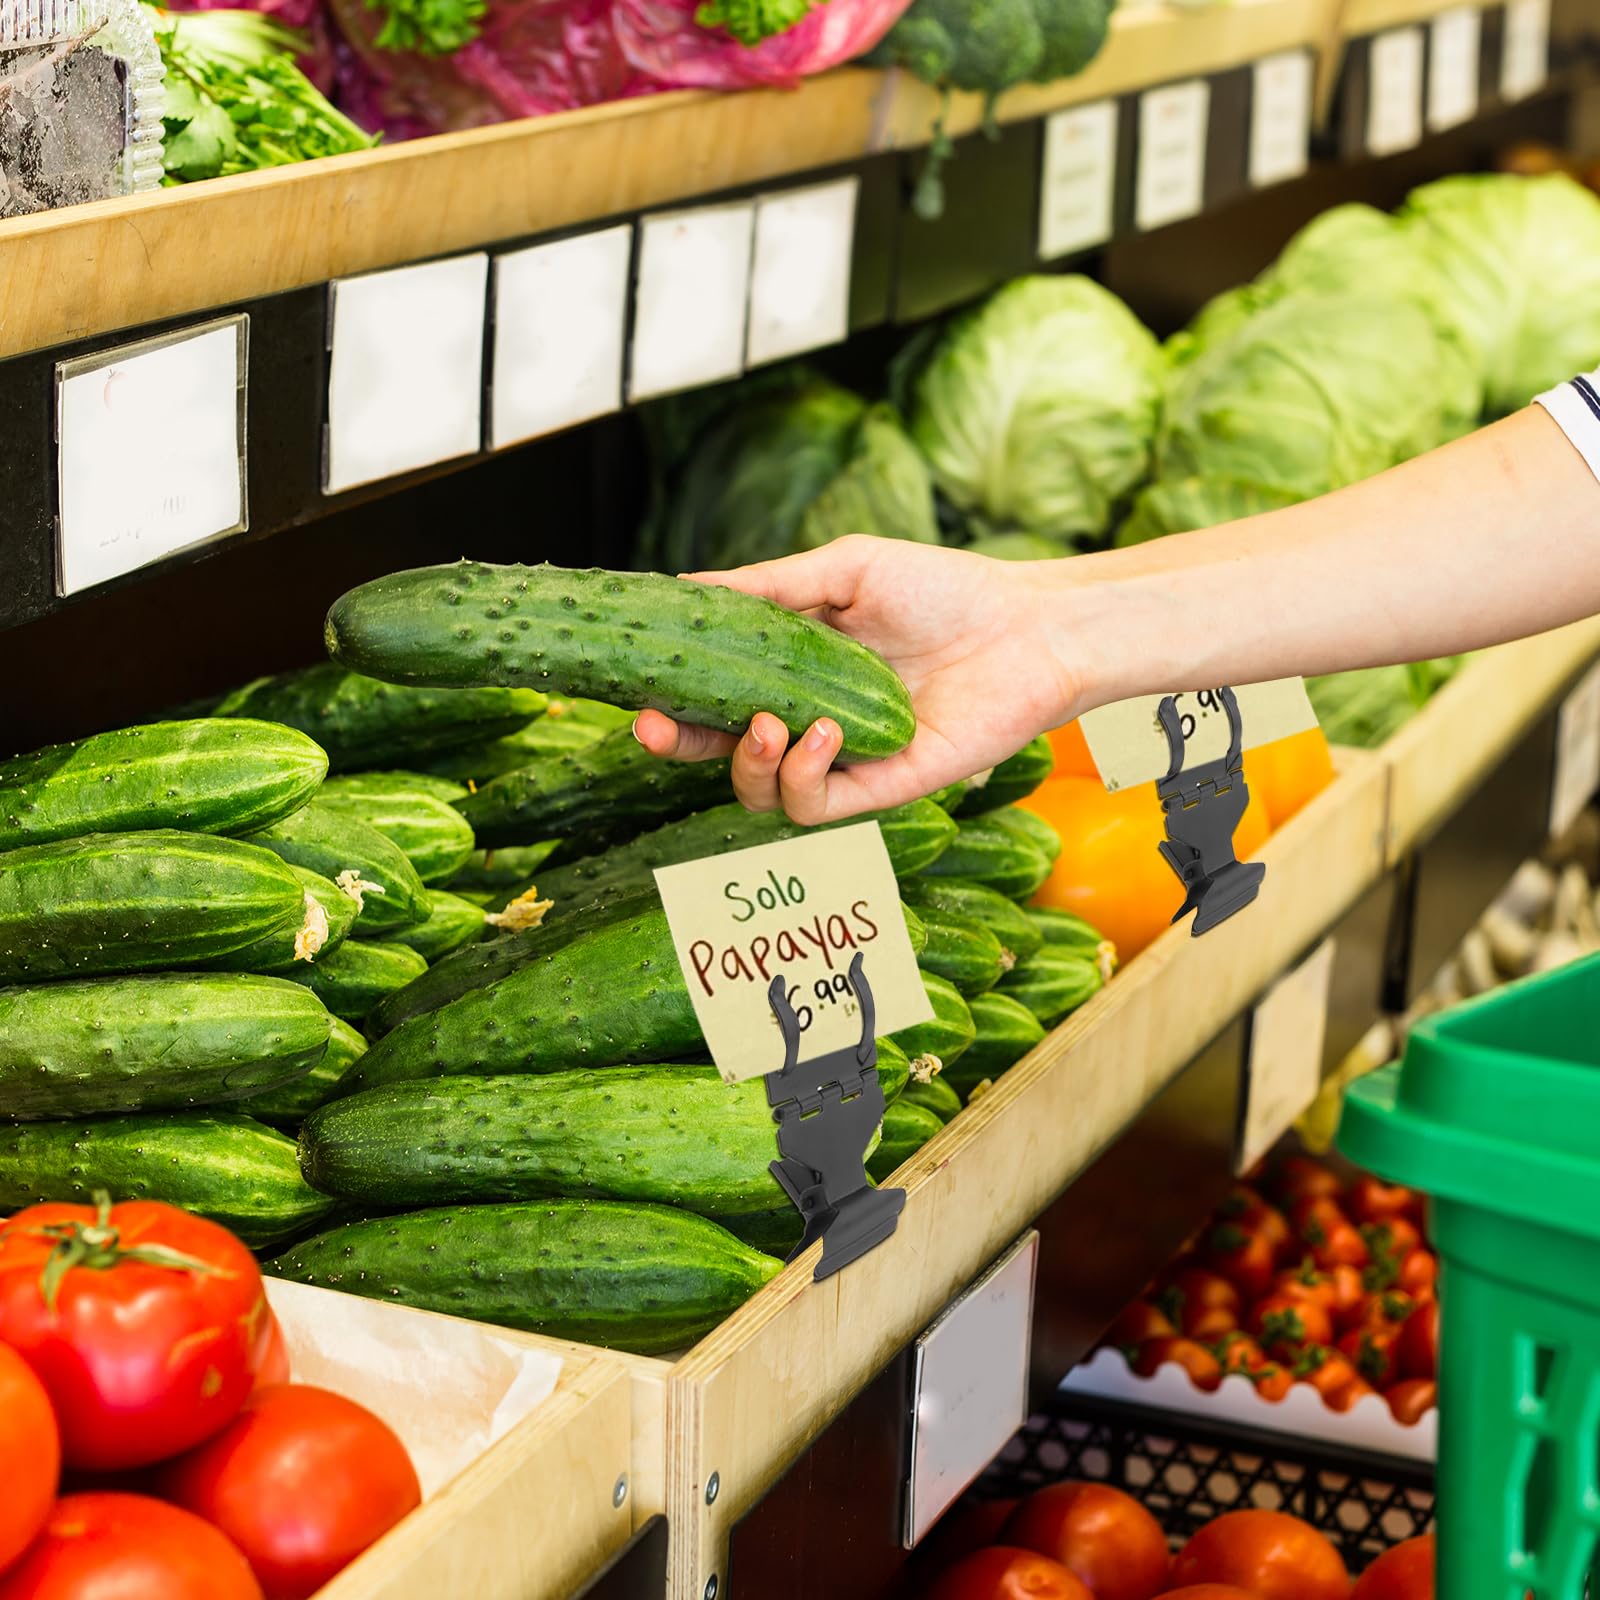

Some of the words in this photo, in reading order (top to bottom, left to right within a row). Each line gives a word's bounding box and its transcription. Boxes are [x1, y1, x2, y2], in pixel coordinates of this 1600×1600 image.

[724, 870, 806, 922] Solo
[689, 900, 878, 997] Papayas
[771, 973, 854, 1032] 6.99
